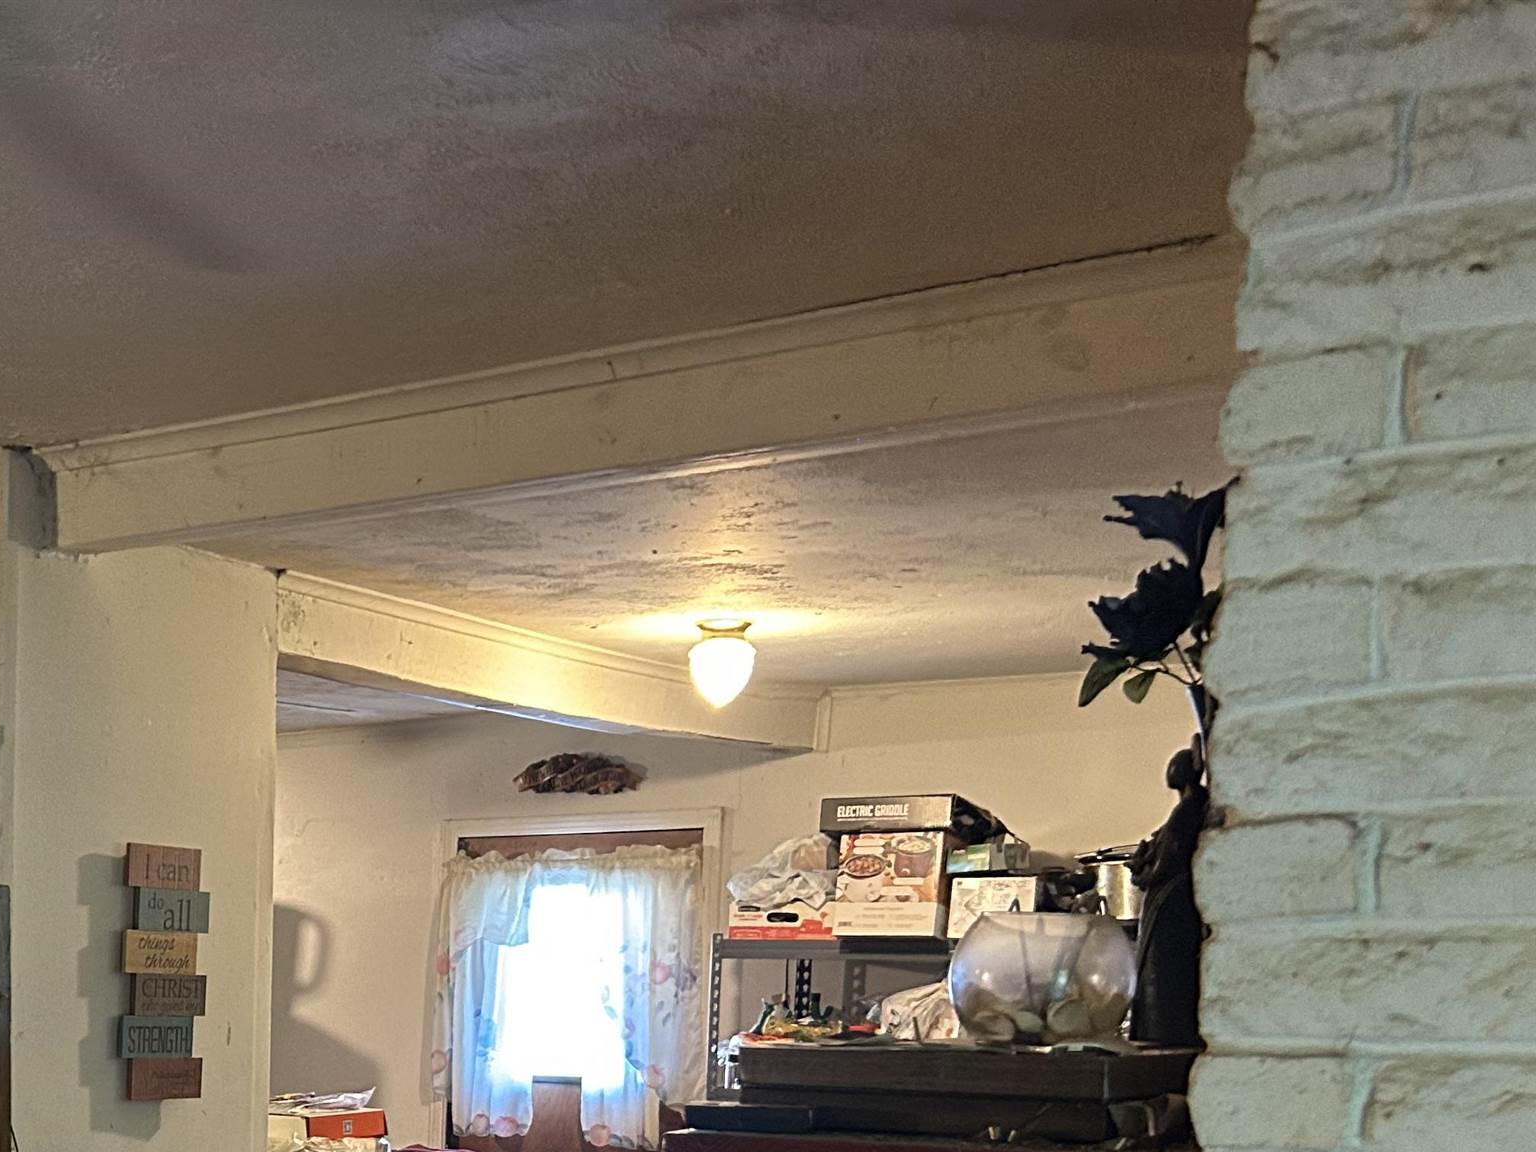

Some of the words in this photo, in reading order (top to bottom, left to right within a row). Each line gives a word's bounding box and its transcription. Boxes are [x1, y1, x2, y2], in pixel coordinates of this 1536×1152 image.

[836, 804, 873, 818] ELECTRIC
[874, 803, 909, 817] GRIDDLE
[144, 853, 151, 880] I
[156, 861, 190, 883] can
[148, 891, 164, 910] do
[163, 898, 191, 931] all
[138, 935, 175, 957] things
[144, 952, 190, 976] through
[141, 977, 201, 999] CHRIST
